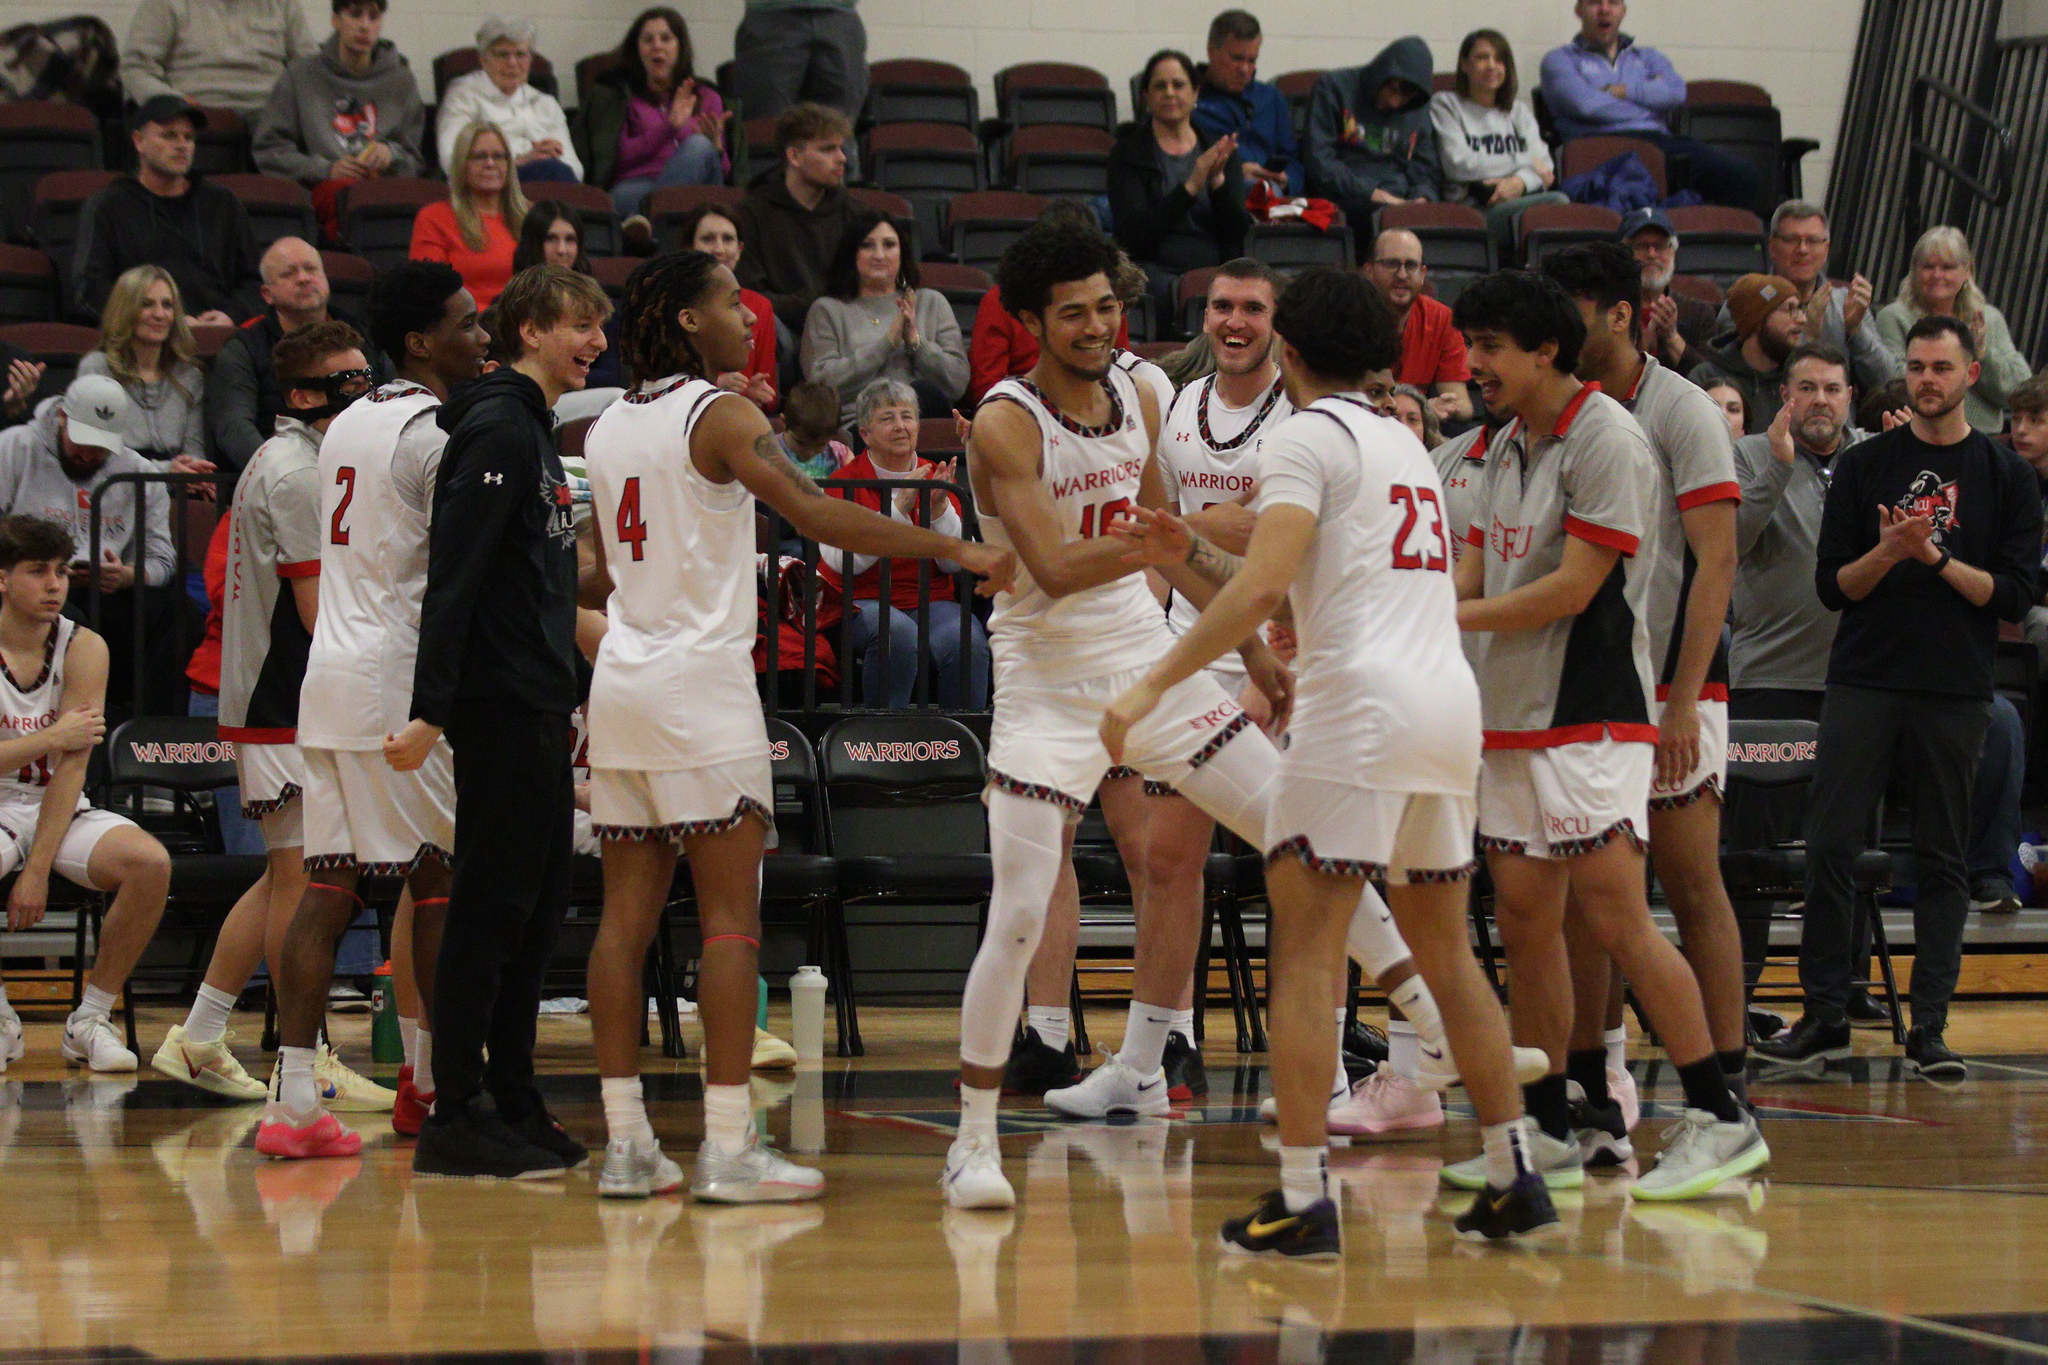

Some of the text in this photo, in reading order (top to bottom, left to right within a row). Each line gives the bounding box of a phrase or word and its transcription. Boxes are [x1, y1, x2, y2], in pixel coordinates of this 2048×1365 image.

[1052, 458, 1141, 500] WARRIORS
[1179, 471, 1254, 492] WARRIOR
[331, 466, 356, 546] 2
[616, 476, 647, 562] 4
[1390, 484, 1447, 574] 23
[130, 741, 237, 764] WARRIOR
[843, 740, 961, 762] WARRIORS
